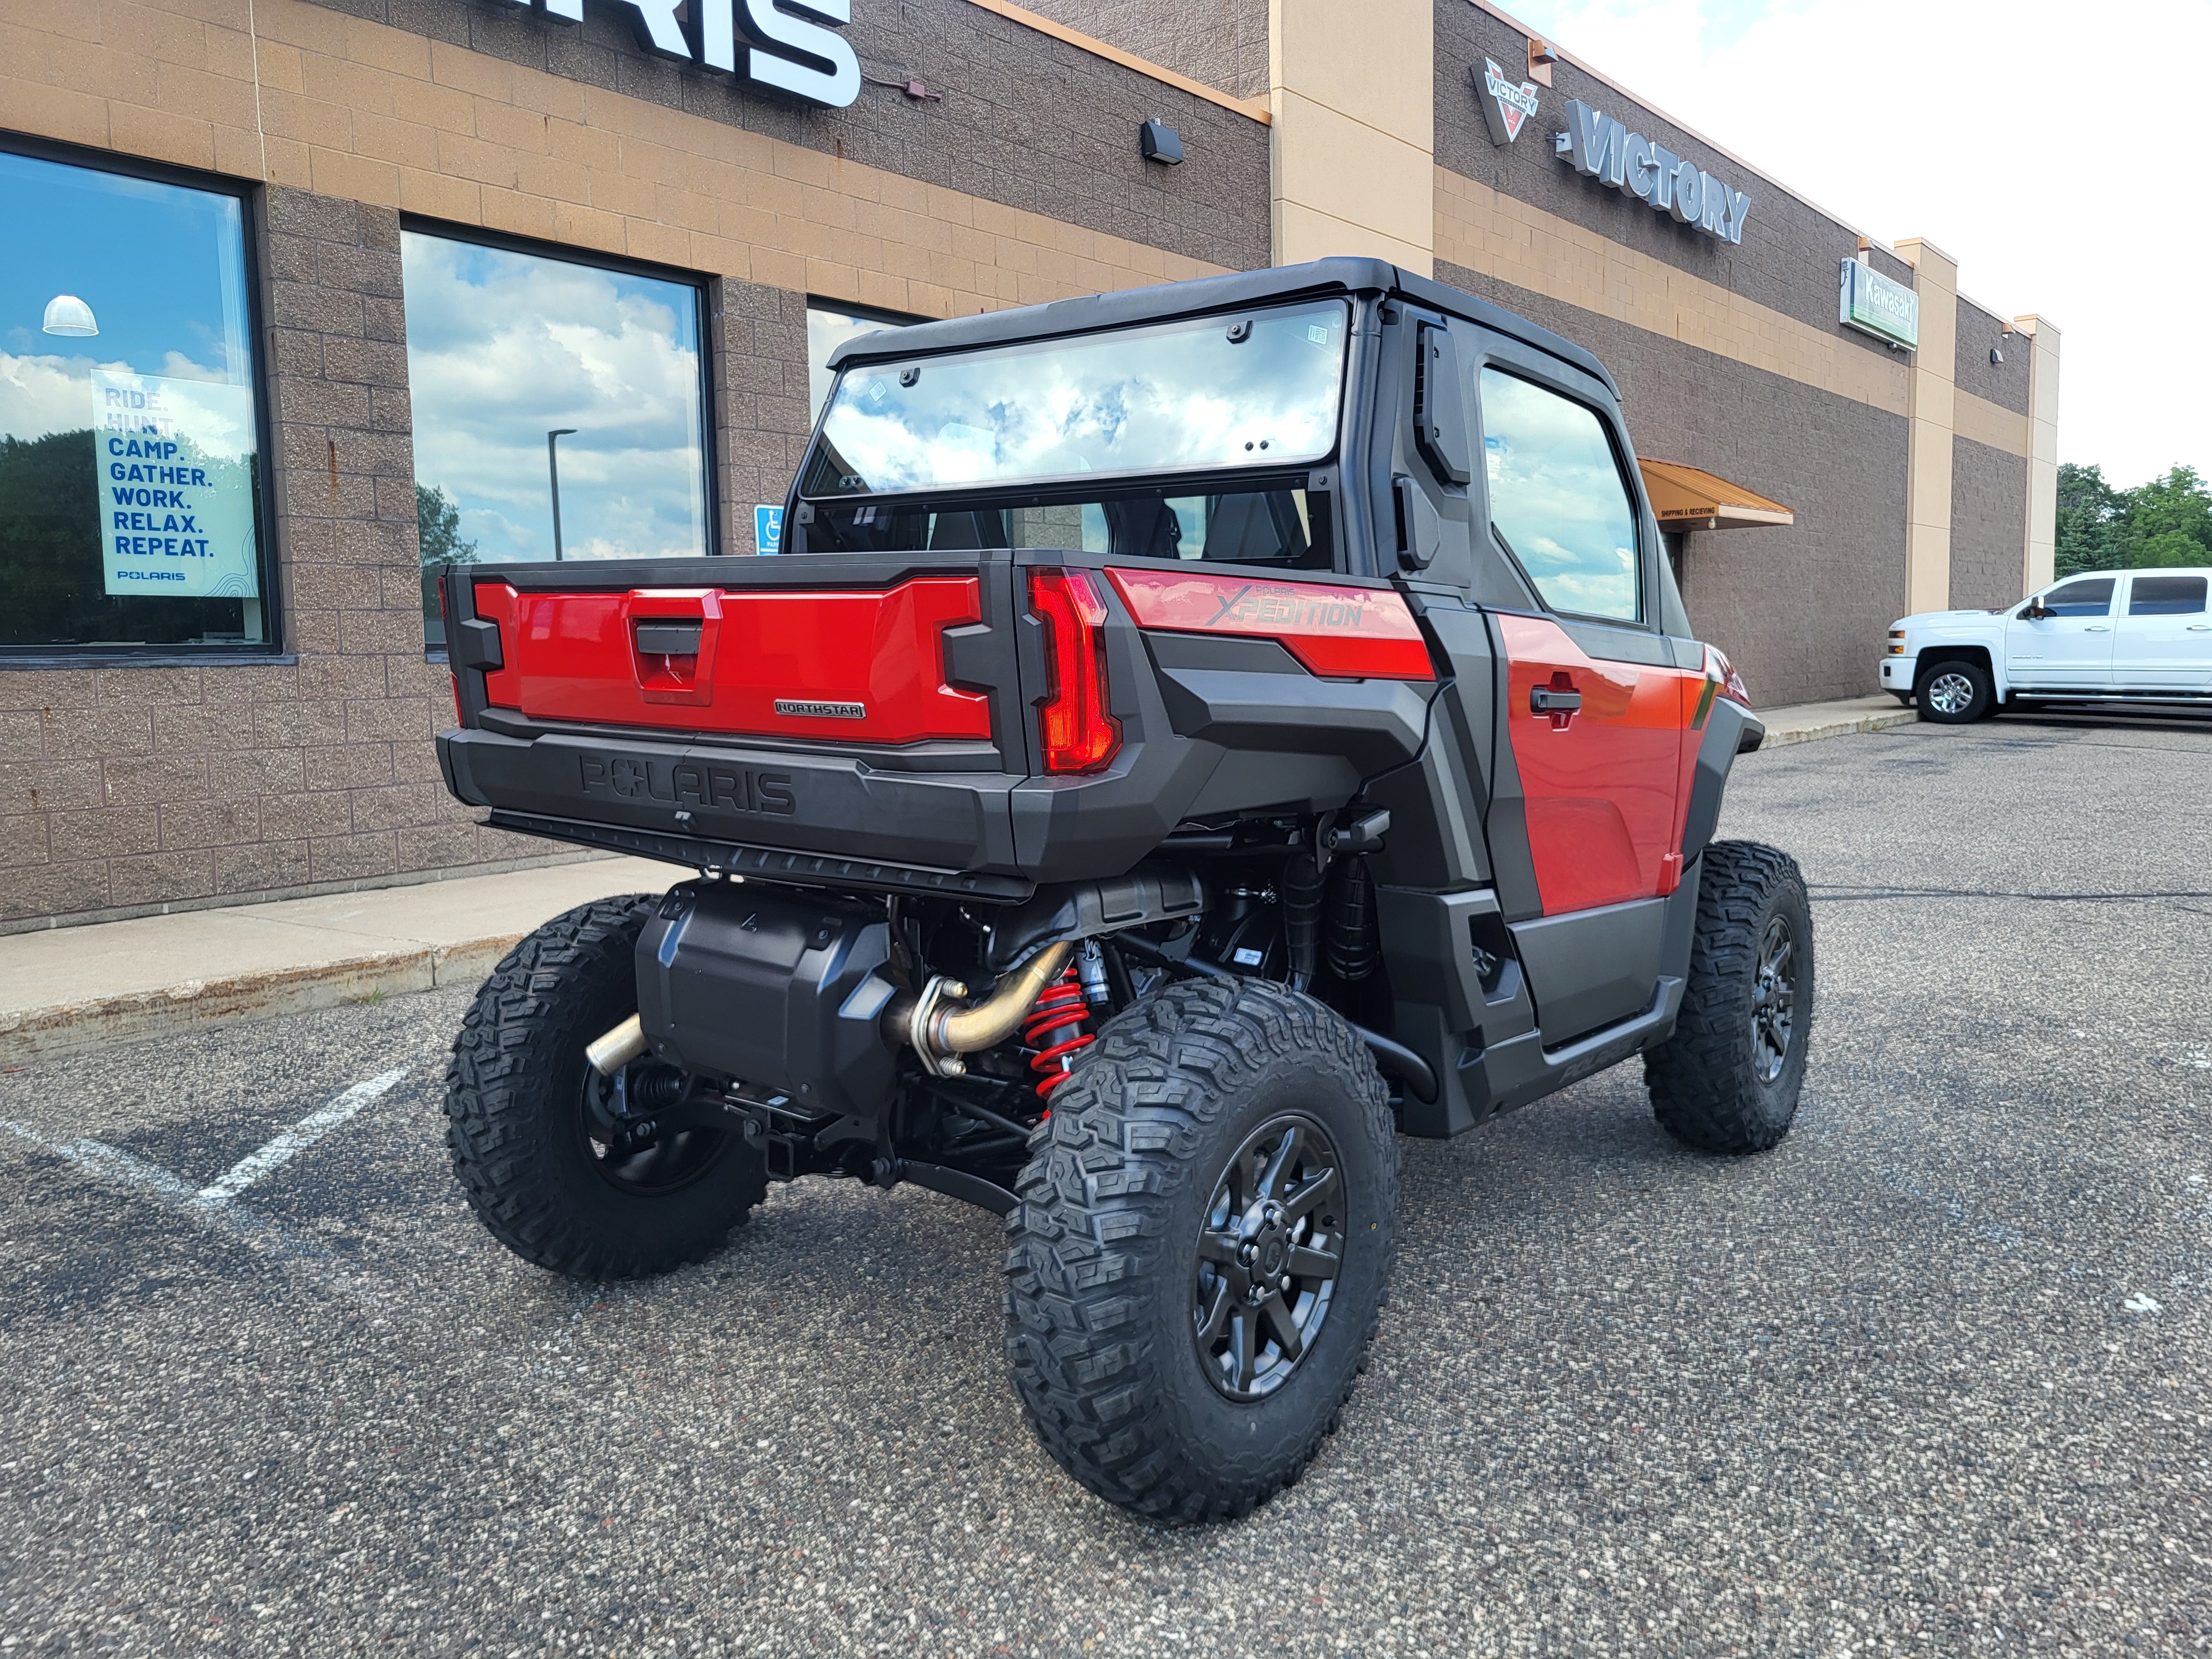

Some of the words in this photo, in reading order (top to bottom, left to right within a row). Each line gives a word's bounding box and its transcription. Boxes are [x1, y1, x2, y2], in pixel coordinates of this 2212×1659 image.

[1489, 78, 1535, 111] VICTORY
[1569, 98, 1752, 245] VICTORY
[1865, 273, 1913, 322] Kawasaki
[105, 388, 168, 412] RIDE.
[107, 413, 179, 439] HUNT.
[108, 437, 185, 461] CAMP.
[110, 462, 213, 487] GATHER.
[111, 487, 192, 509] WORK.
[113, 512, 204, 534] RELAX.
[1661, 509, 1683, 517] SHIPPING
[1689, 507, 1715, 515] RECIEVING
[115, 536, 214, 557] REPEAT.
[117, 571, 186, 581] POLARIS
[1256, 586, 1295, 596] POLARIS
[1204, 585, 1362, 627] XPEDITION
[778, 703, 859, 716] NORTHSTAR
[579, 755, 797, 815] POLARIS
